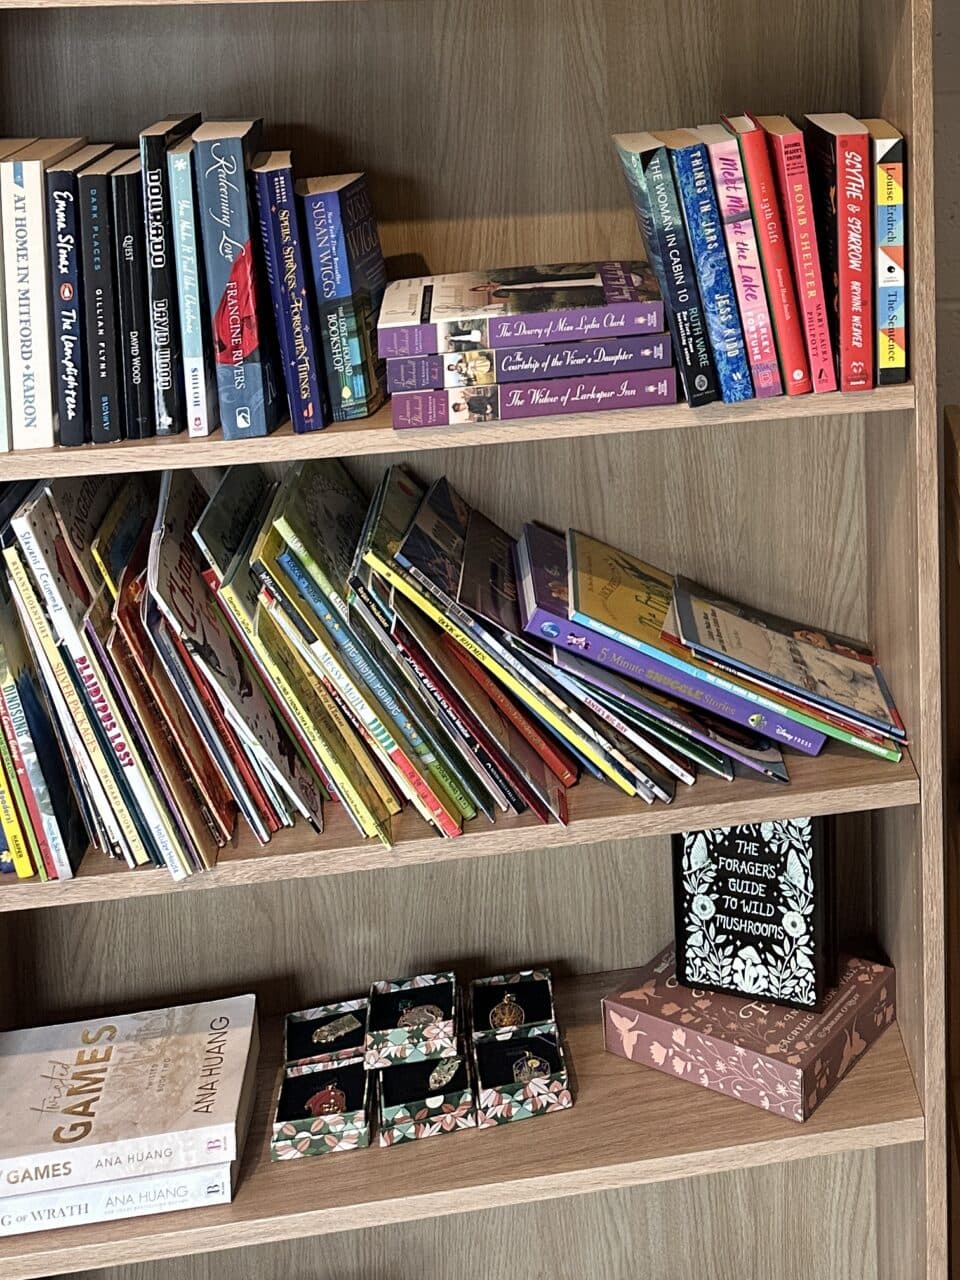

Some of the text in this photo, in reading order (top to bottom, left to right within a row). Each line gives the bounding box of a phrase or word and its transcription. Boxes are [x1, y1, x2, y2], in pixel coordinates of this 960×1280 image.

[845, 151, 863, 200] SCYTHE
[886, 167, 896, 243] Louise Erdrich
[90, 189, 101, 271] DARK PLACES
[311, 201, 337, 298] SUSAN WIGGS
[650, 158, 689, 303] THE WOMAN IN CABIN 10
[793, 183, 817, 299] BOMB SHELTER
[847, 214, 863, 272] SPARROW
[95, 288, 107, 379] GILLIAN FLYNN
[688, 306, 710, 368] RUTH WARE
[886, 290, 898, 362] The Sentence
[3, 684, 30, 738] DINOSONG
[55, 662, 99, 754] SILVER PACKAGES
[76, 655, 135, 769] PLAIDYPUS LOST
[320, 652, 367, 712] Messy Molly
[718, 856, 777, 879] FORAGER'S
[735, 840, 759, 856] THE
[722, 896, 775, 916] TO WILD
[728, 878, 767, 897] GUIDE
[715, 914, 785, 940] MUSHROOMS
[52, 1023, 119, 1144] GAMES
[193, 1016, 230, 1114] ANA HUANG
[6, 1161, 73, 1185] GAMES
[95, 1148, 173, 1170] ANA HUANG
[105, 1186, 189, 1208] ANA HUANG
